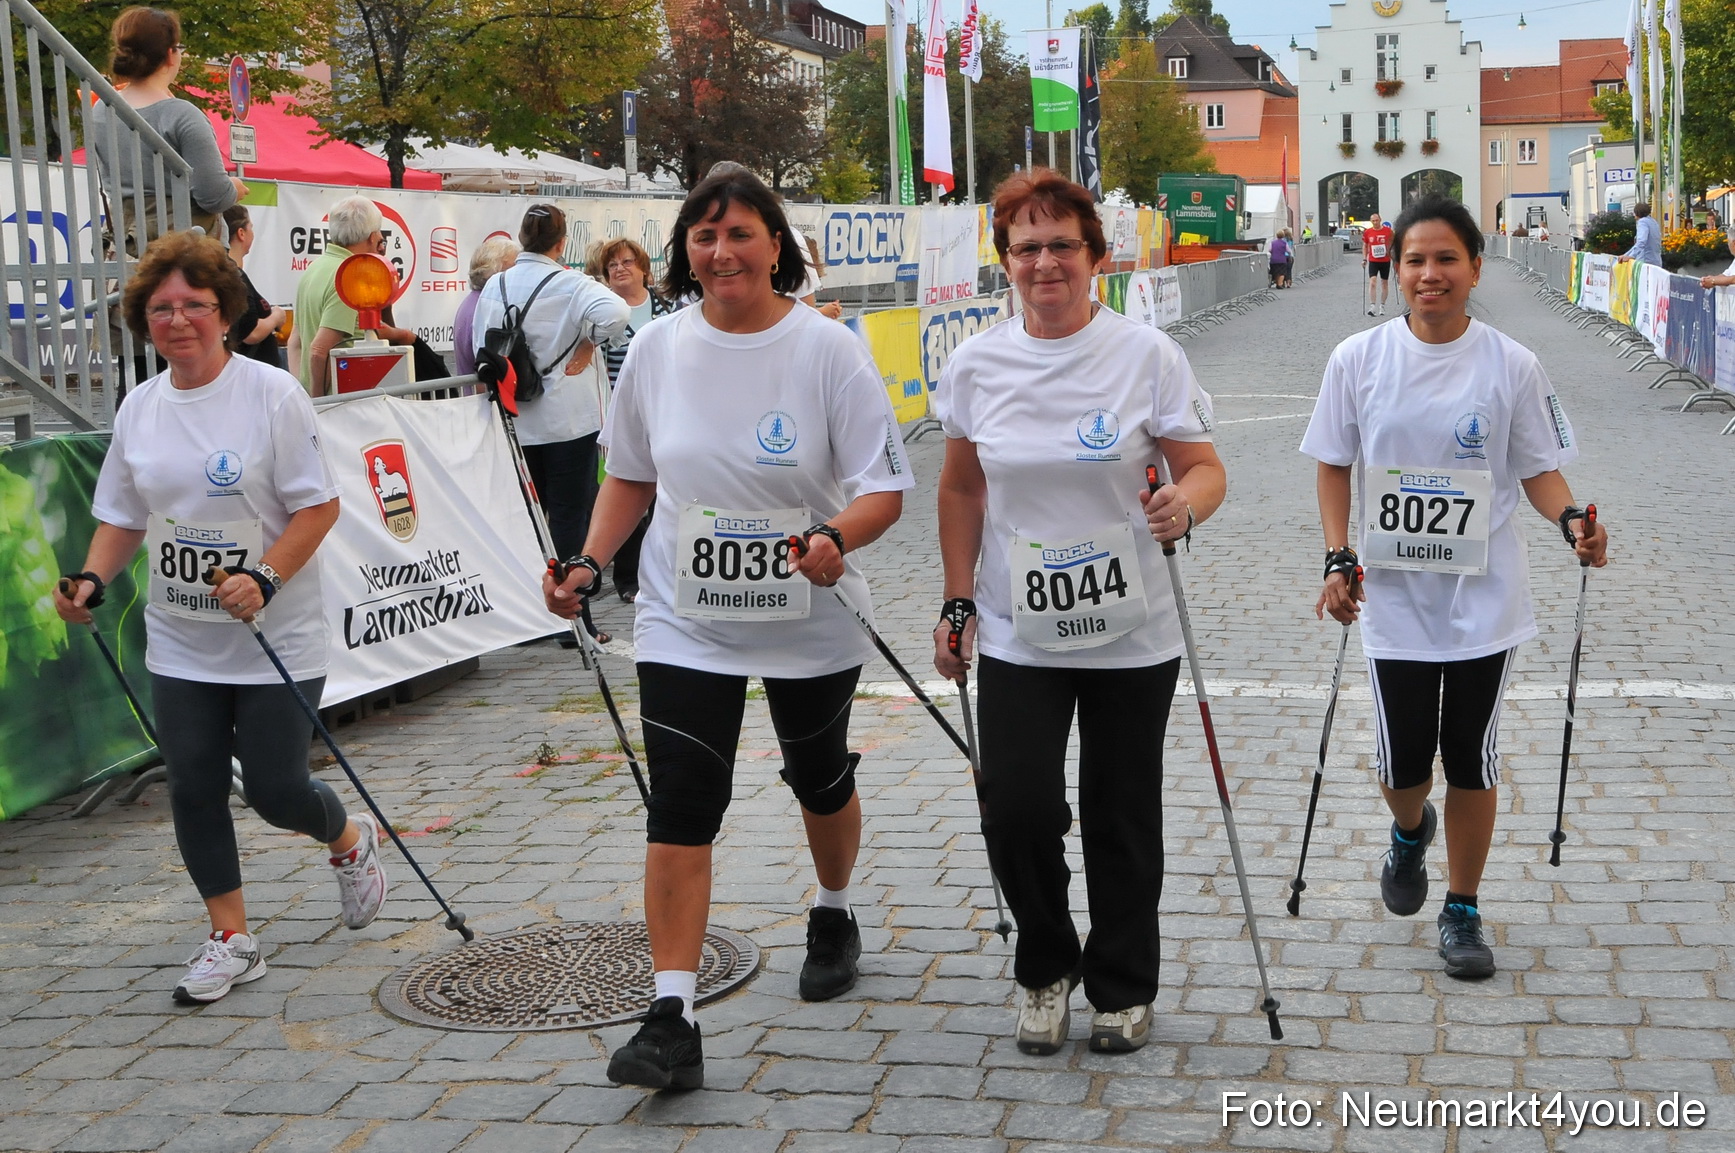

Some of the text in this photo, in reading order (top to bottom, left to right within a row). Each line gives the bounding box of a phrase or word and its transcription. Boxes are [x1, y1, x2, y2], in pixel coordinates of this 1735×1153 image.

[626, 97, 633, 130] P
[1176, 210, 1216, 218] Lammsbräu
[394, 236, 402, 250] &
[825, 212, 905, 266] BOCK
[421, 280, 467, 292] SEAT
[756, 456, 775, 464] Kloster
[1400, 474, 1450, 488] BOCK
[393, 516, 411, 533] 1628
[1380, 493, 1475, 536] 8027
[174, 526, 224, 540] BOCK
[714, 518, 770, 532] BOCK
[692, 538, 793, 581] 8038
[1042, 541, 1094, 562] BOCK
[1396, 542, 1453, 560] Lucille
[160, 542, 248, 586] 8037
[358, 548, 460, 594] Neumarkter
[681, 570, 687, 578] N
[1026, 556, 1128, 612] 8044
[167, 586, 226, 611] Sieglin
[697, 588, 788, 608] Anneliese
[344, 578, 494, 650] Lammsbräu
[1056, 616, 1106, 638] Stilla
